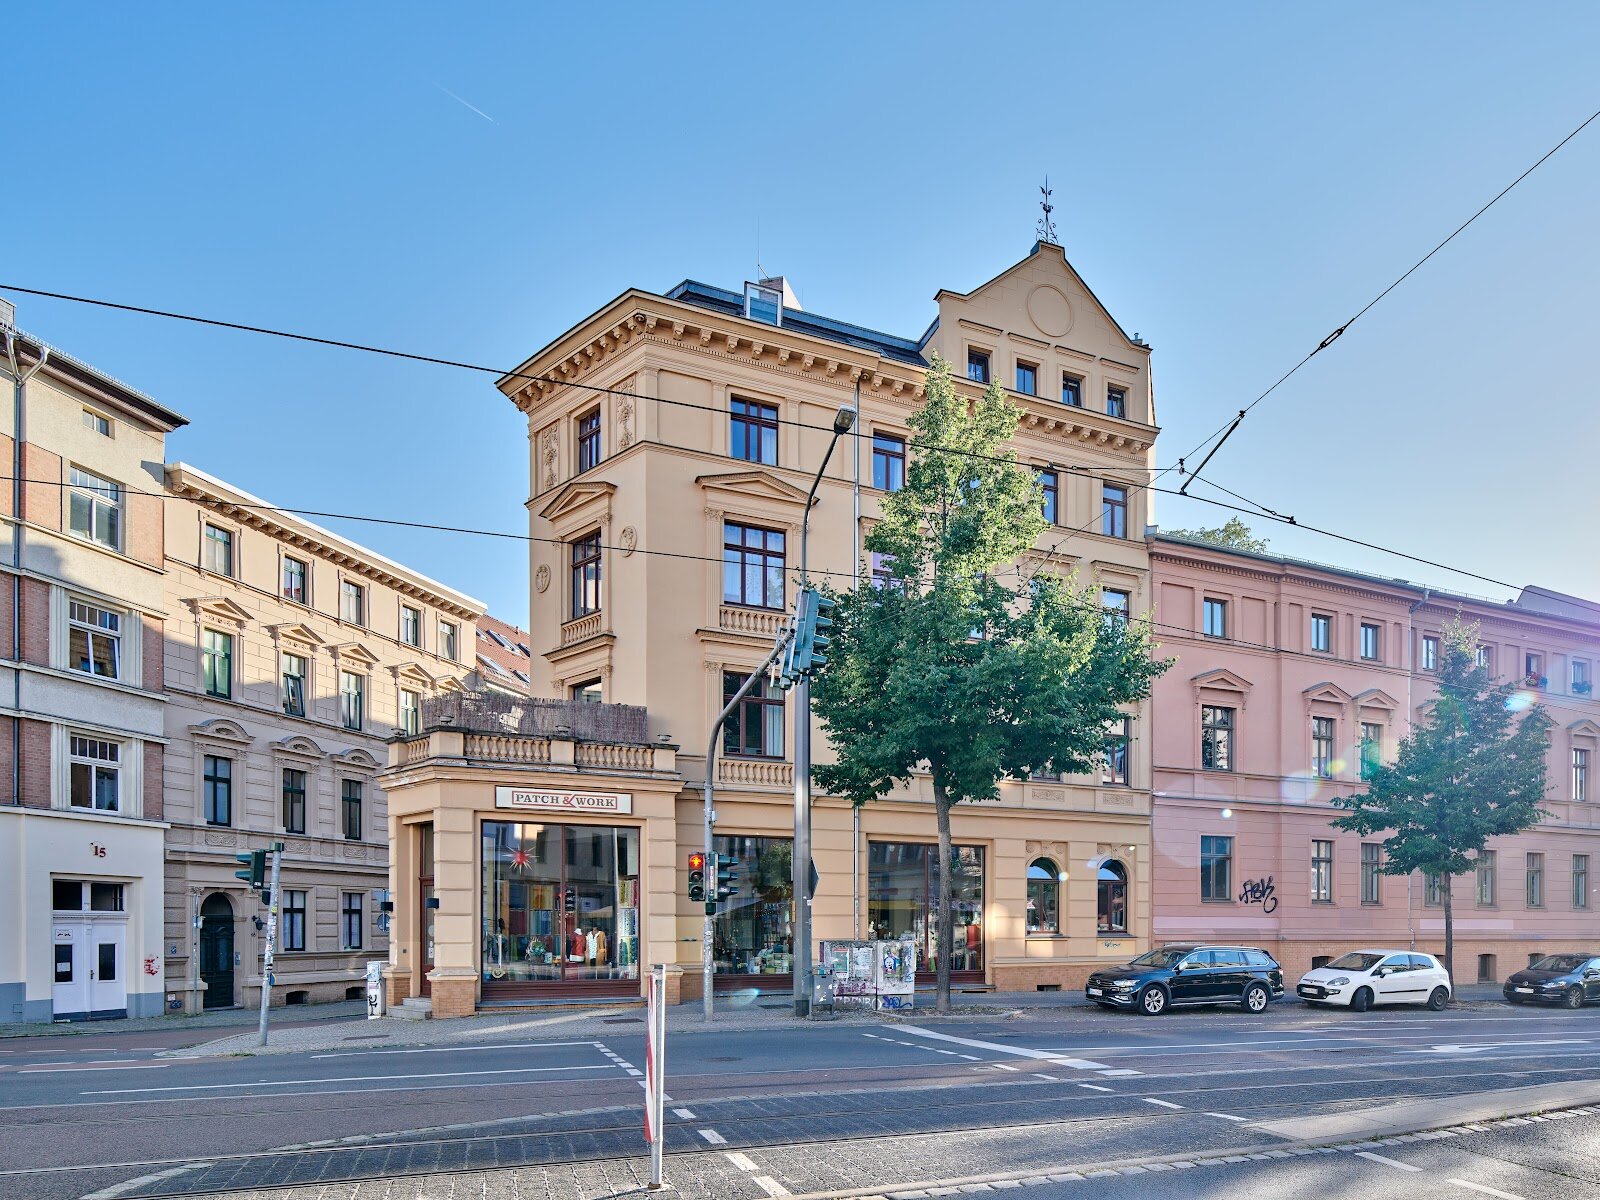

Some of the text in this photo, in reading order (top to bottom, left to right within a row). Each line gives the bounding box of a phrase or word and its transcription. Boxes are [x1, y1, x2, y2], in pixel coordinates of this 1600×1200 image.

[515, 793, 560, 804] PATCH
[576, 797, 614, 807] WORK
[93, 845, 106, 858] 15
